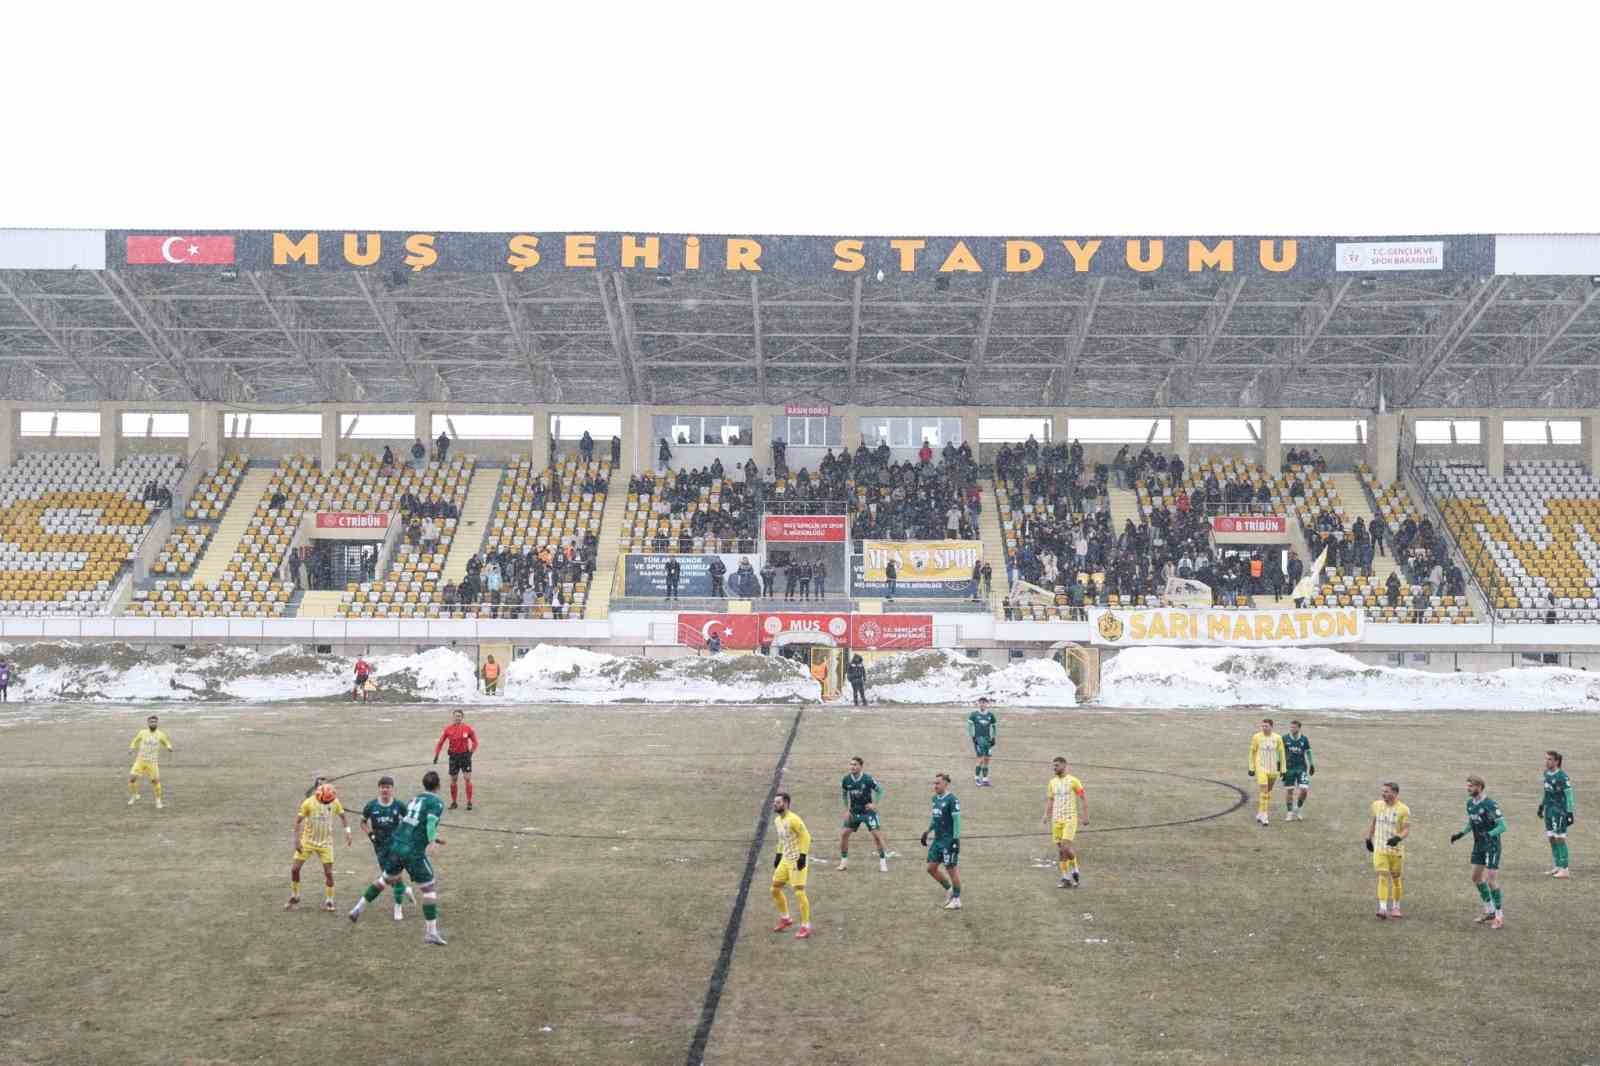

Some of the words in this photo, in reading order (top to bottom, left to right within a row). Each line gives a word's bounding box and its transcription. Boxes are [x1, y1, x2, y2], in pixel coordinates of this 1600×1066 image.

[272, 232, 438, 272] MUŞ
[833, 237, 1298, 275] STADYUMU
[346, 513, 381, 527] TRİBÜN
[1244, 517, 1279, 532] TRİBÜN
[1130, 614, 1198, 641] SARI
[1206, 611, 1358, 640] MARATON
